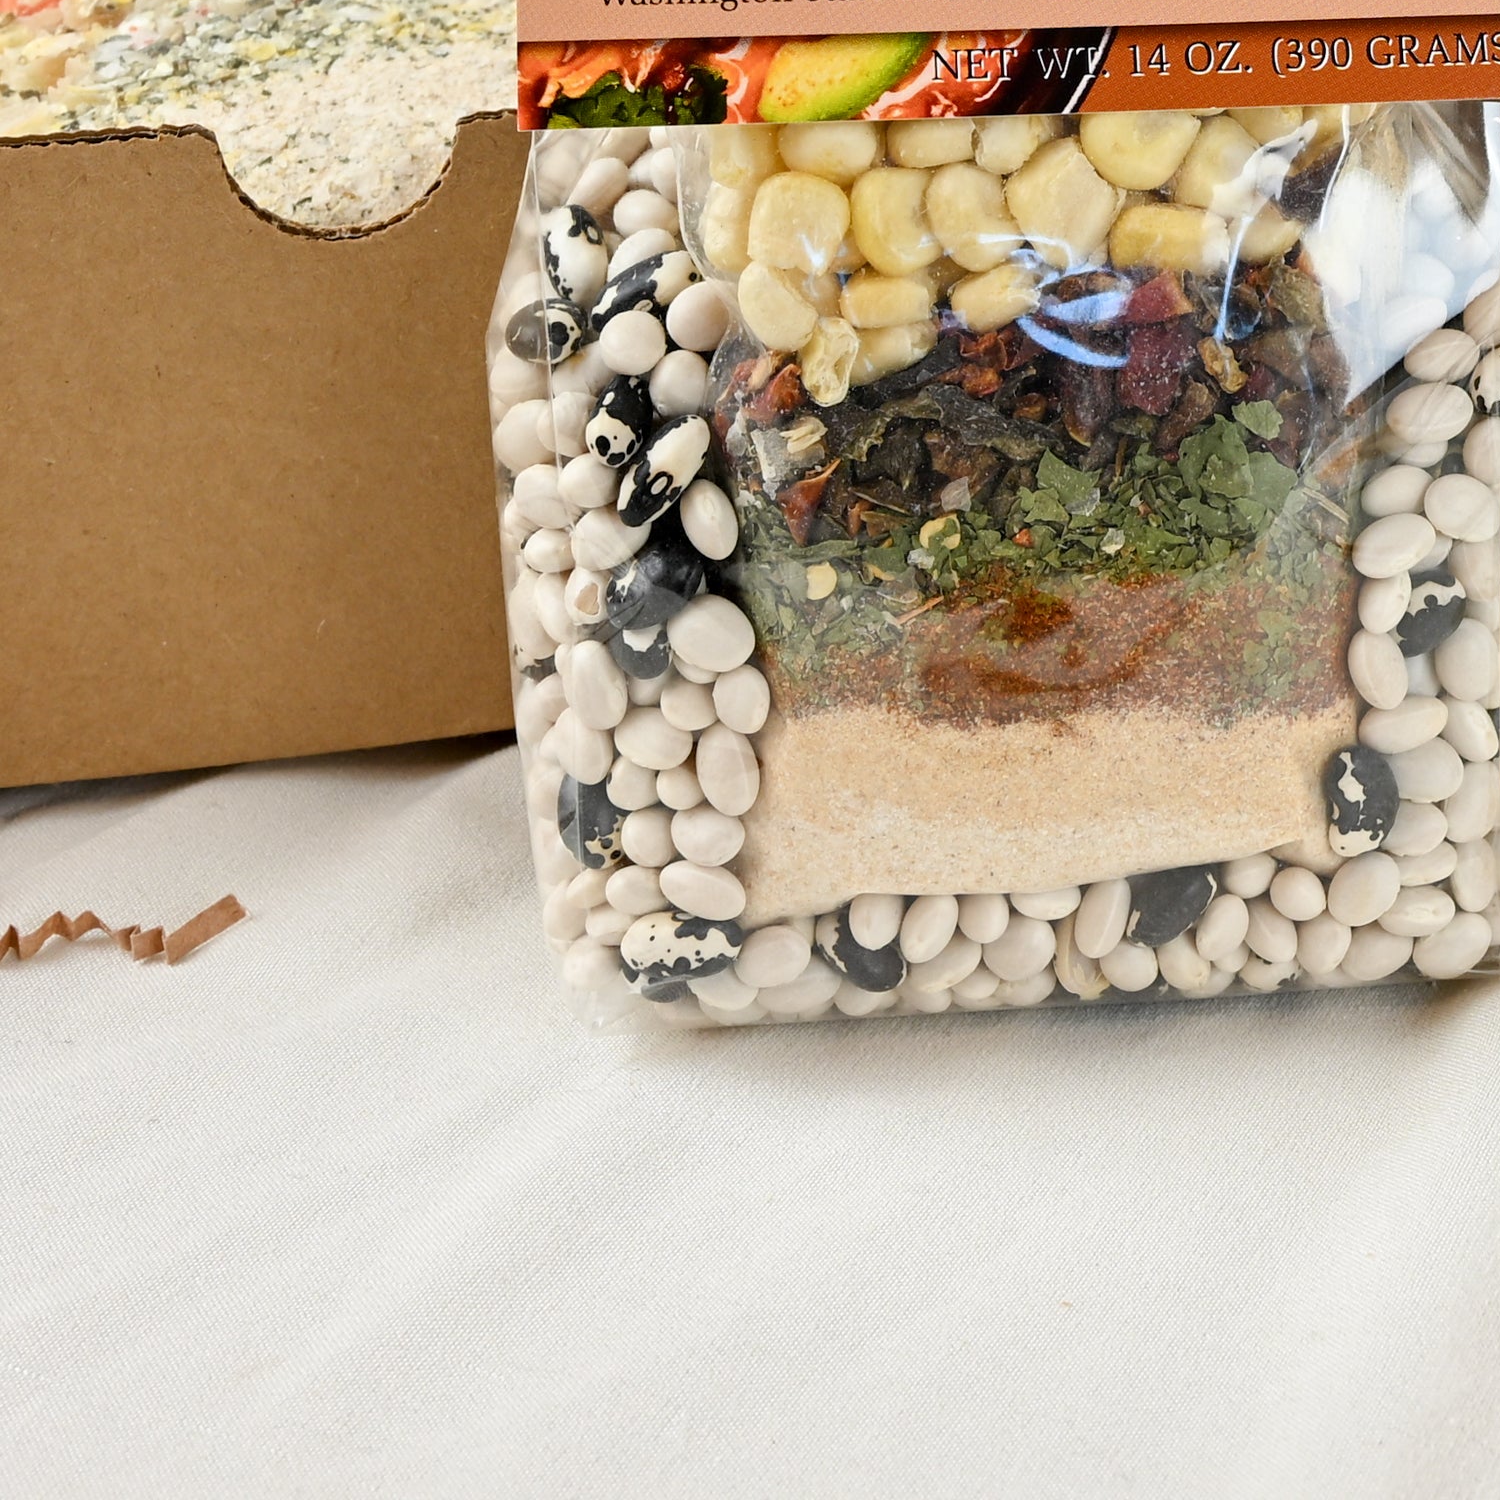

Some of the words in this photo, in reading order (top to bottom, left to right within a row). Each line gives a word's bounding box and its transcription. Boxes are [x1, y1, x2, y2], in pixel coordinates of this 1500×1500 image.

[932, 48, 1017, 82] NET
[1033, 46, 1111, 80] WT.
[1128, 43, 1171, 77] 14
[1185, 40, 1252, 75] OZ.
[1271, 36, 1353, 78] (390
